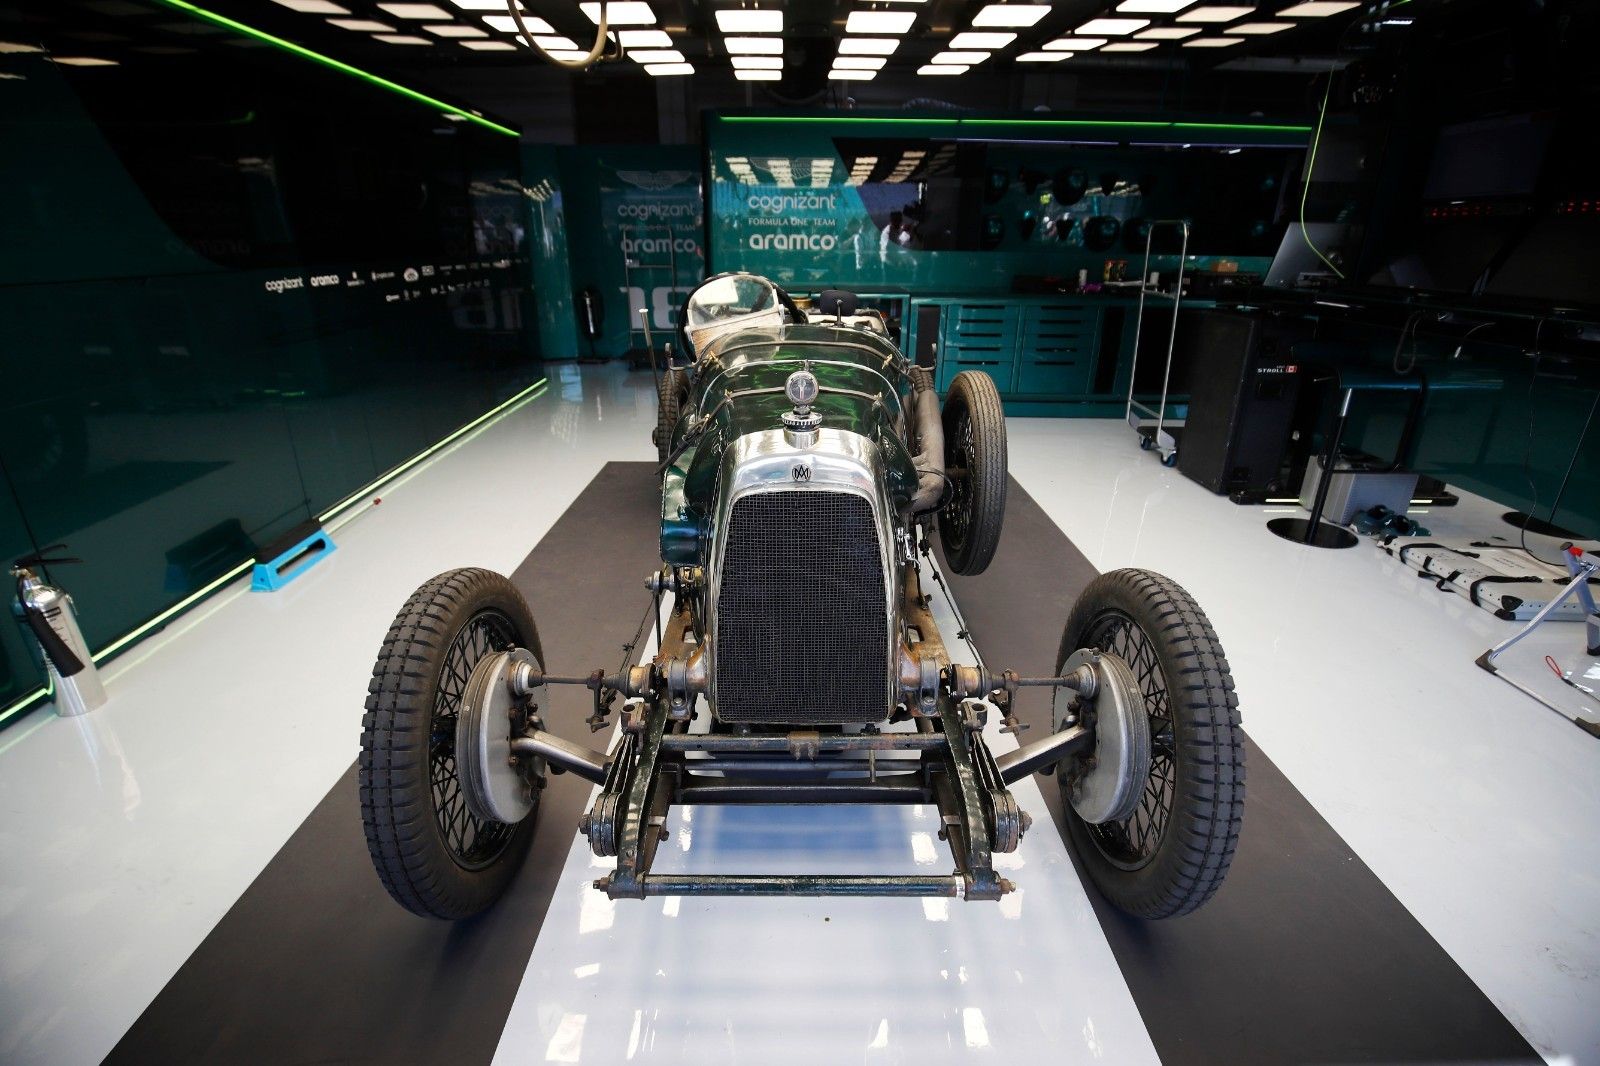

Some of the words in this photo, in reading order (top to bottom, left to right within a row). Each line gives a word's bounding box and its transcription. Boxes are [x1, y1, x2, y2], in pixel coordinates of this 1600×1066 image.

[618, 202, 695, 220] cognizant
[748, 194, 836, 213] cognizant
[748, 218, 788, 226] FORMULA
[790, 217, 808, 226] ONE
[814, 218, 836, 226] TEAM
[620, 239, 696, 253] aramco
[749, 233, 836, 250] aramco
[265, 277, 304, 293] cognizant
[310, 275, 340, 287] aramco
